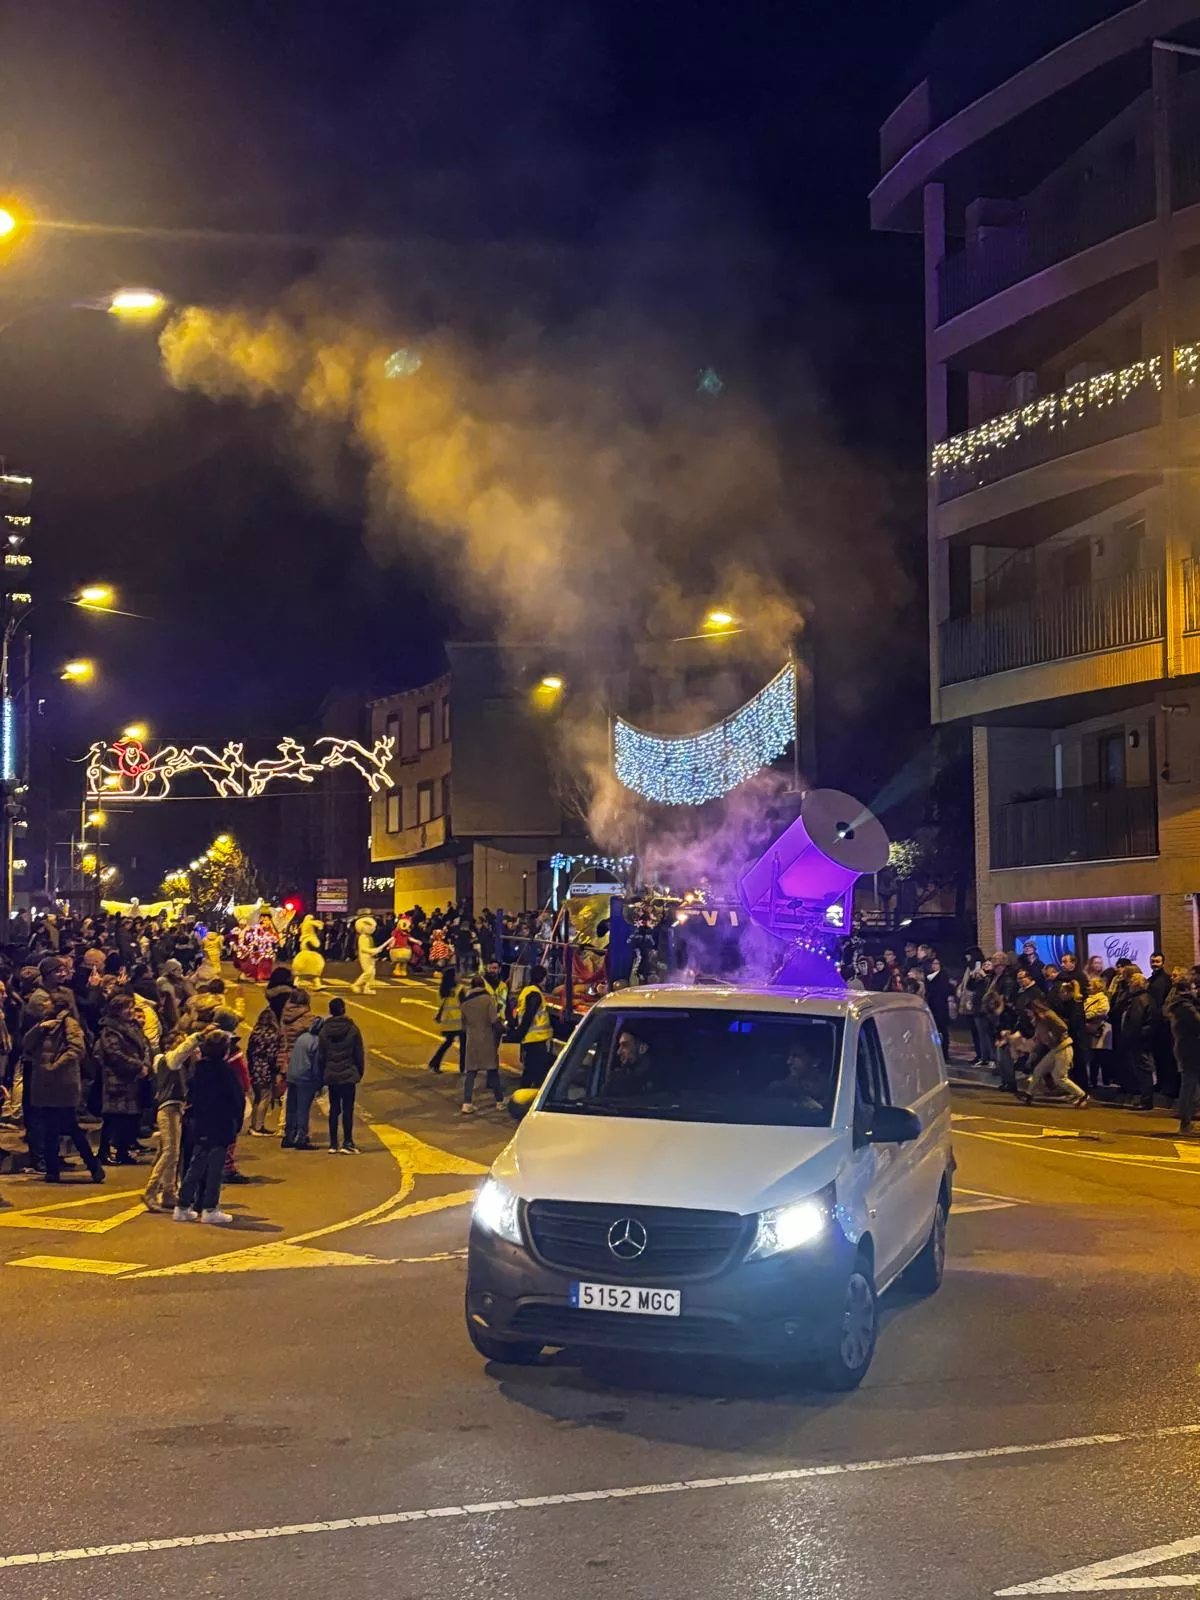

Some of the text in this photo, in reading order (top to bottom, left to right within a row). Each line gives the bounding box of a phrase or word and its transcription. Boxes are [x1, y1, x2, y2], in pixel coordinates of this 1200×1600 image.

[1104, 935, 1132, 966] Café
[584, 1286, 675, 1311] 5152 MGC
